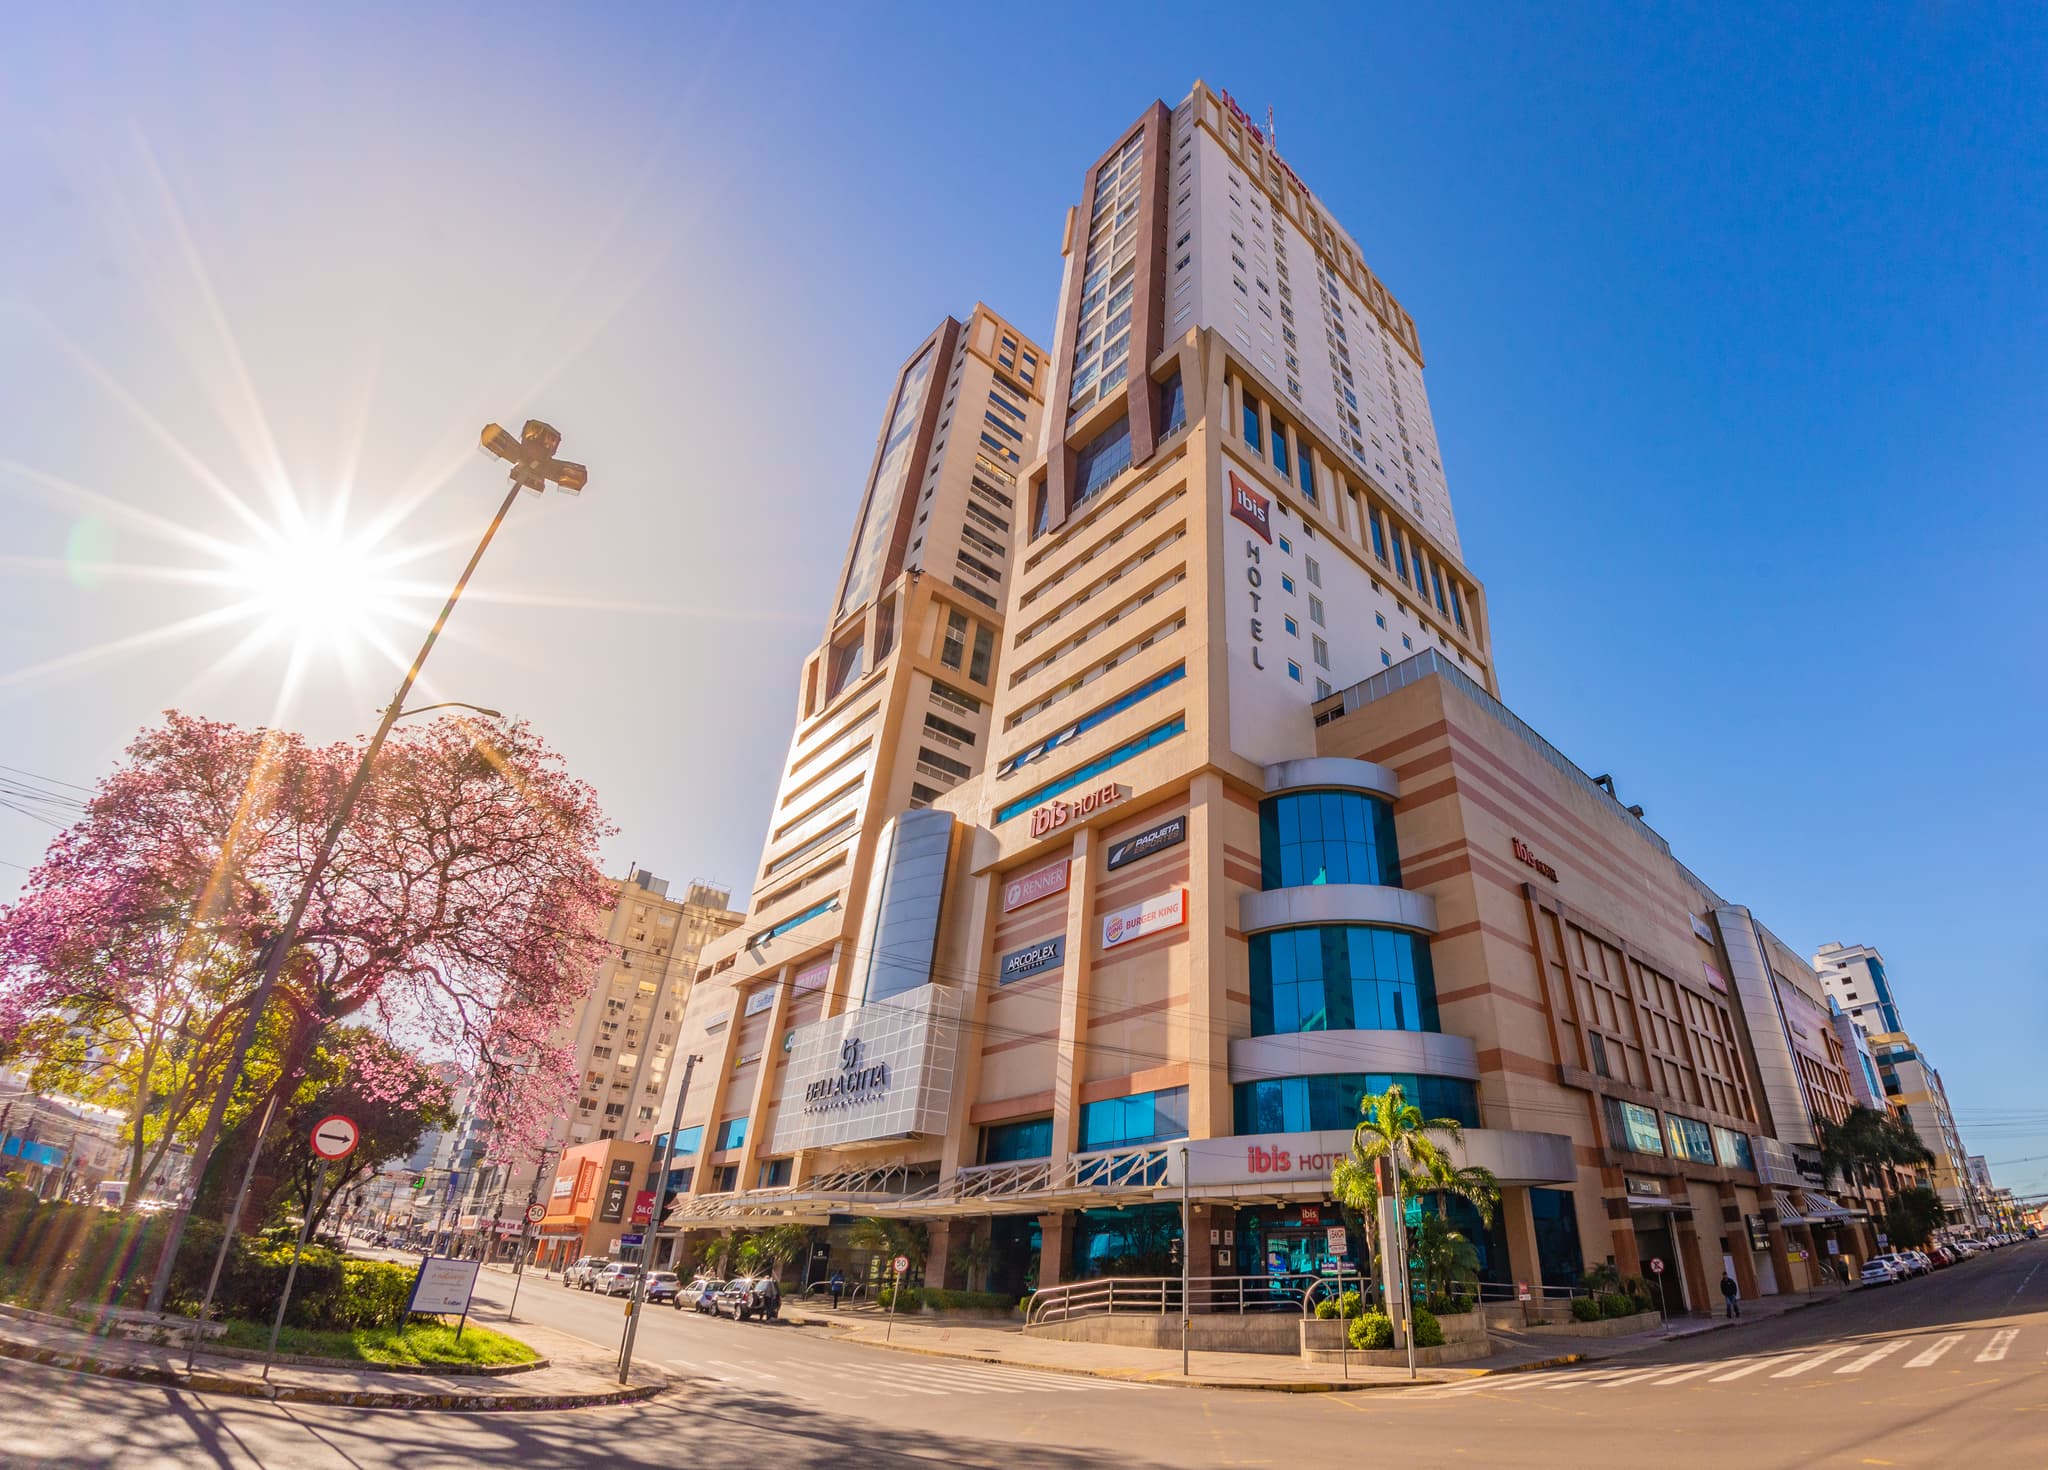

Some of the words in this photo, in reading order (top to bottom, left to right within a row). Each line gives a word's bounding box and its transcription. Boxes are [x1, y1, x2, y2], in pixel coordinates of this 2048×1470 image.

[1236, 488, 1267, 523] ibis
[1246, 540, 1265, 671] HOTEL
[1030, 800, 1068, 838] ibis
[1072, 782, 1121, 818] HOTEL
[1022, 868, 1063, 898] RENNER
[1126, 910, 1157, 930] BURGER
[1158, 903, 1179, 918] KING
[1007, 943, 1056, 971] ARCOPLEX
[805, 1075, 844, 1103] BELLA
[1247, 1145, 1291, 1173] ibis
[531, 1207, 543, 1218] 50
[1301, 1208, 1317, 1219] ibis
[896, 1259, 906, 1268] 50
